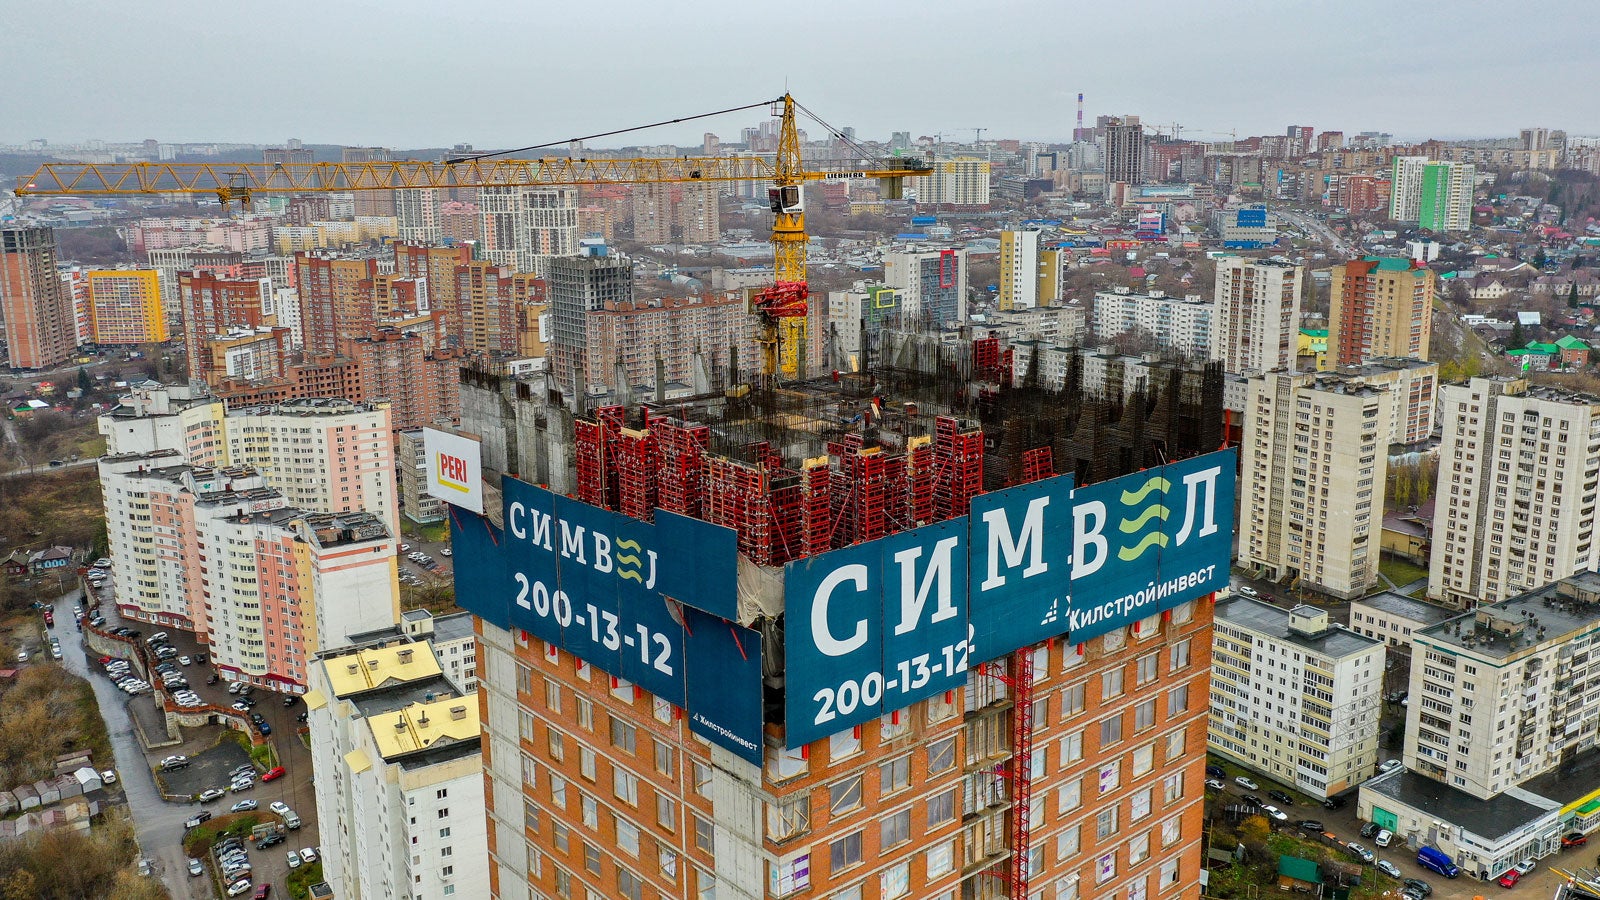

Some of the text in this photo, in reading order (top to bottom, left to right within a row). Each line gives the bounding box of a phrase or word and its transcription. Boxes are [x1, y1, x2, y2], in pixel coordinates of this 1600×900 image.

[440, 453, 467, 483] PERI
[514, 572, 673, 676] 200-13-12
[813, 623, 975, 726] 200-13-12
[699, 714, 758, 751] Жилстройинвест
